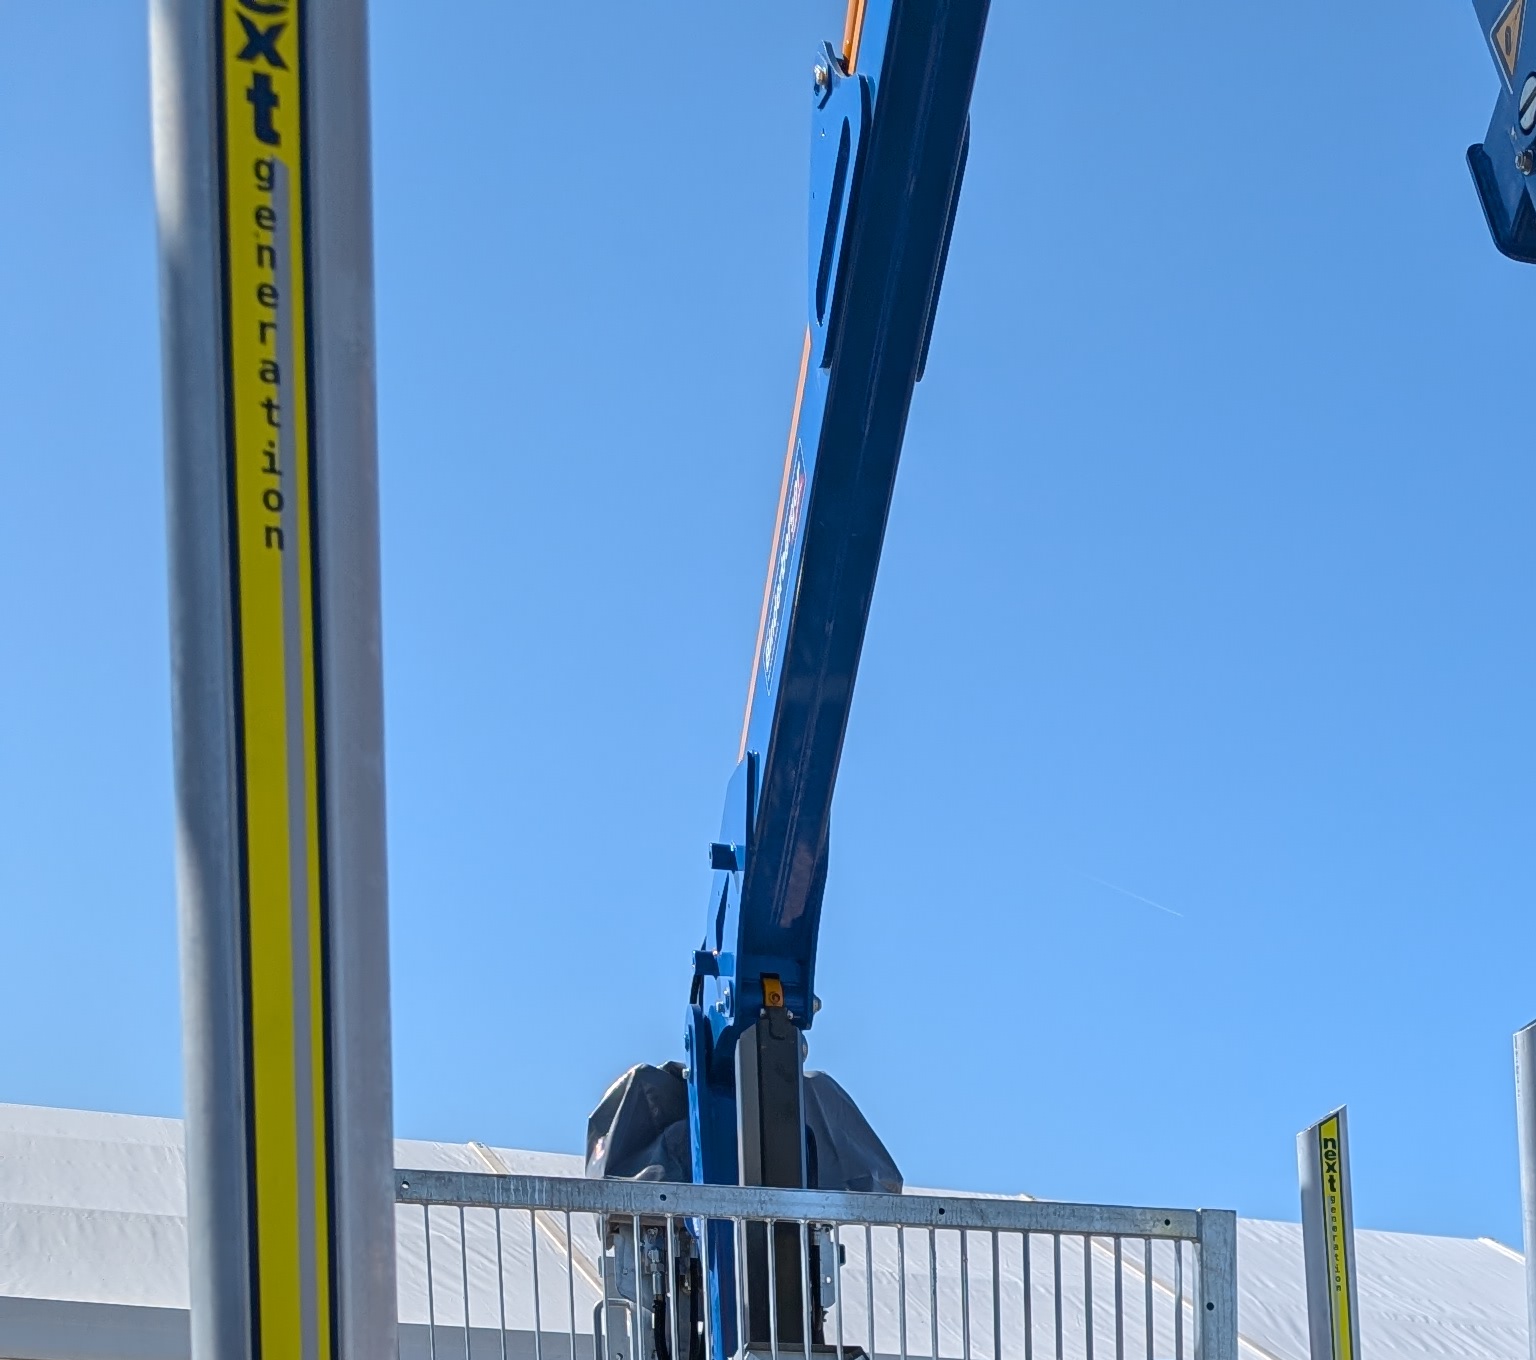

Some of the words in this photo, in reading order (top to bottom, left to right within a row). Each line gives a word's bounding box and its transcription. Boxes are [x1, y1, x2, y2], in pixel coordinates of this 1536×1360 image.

[235, 0, 288, 147] xt
[253, 157, 285, 550] generation
[1323, 1137, 1338, 1193] next
[1330, 1195, 1342, 1292] generation
